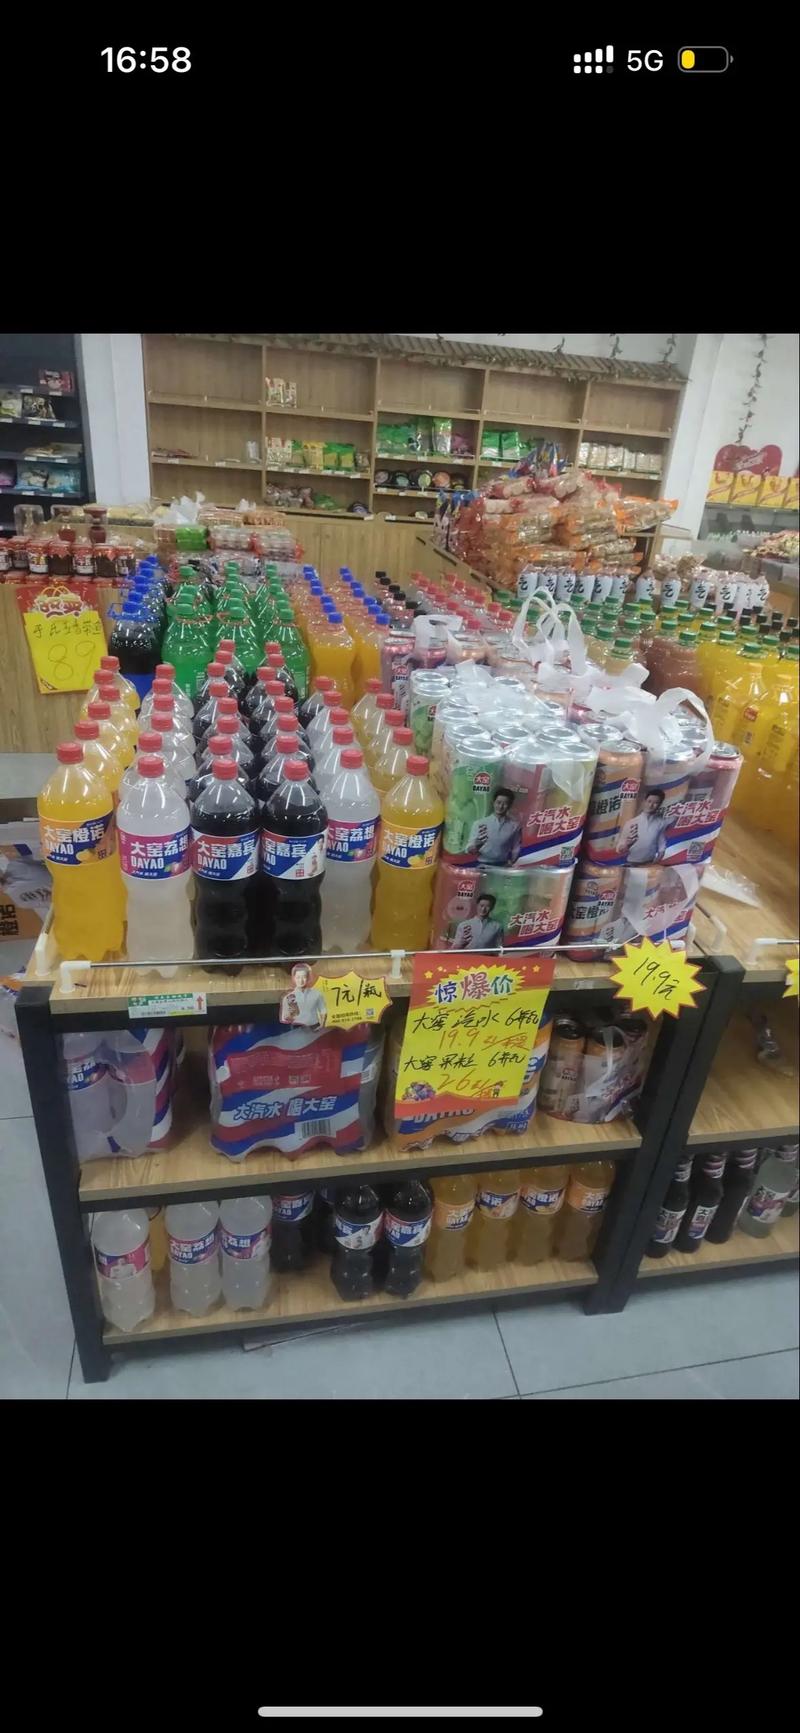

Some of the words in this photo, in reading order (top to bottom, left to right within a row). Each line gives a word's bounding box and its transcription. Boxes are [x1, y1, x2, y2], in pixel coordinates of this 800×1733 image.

[529, 807, 571, 827] 大汽水
[43, 823, 105, 843] 大窑橙诺
[384, 828, 436, 849] 大窑橙诺
[130, 835, 189, 857] 大窑荔想
[197, 838, 256, 858] 大窑嘉宾
[130, 855, 164, 870] DAYAO
[197, 854, 227, 870] DAYAO
[508, 910, 550, 928] 大汽水
[435, 971, 514, 1003] 惊爆价
[632, 956, 681, 1001] 19.9元
[331, 979, 382, 1007] 7元/瓶
[233, 1101, 282, 1121] 大汽水
[286, 1096, 338, 1117] 喝大窑
